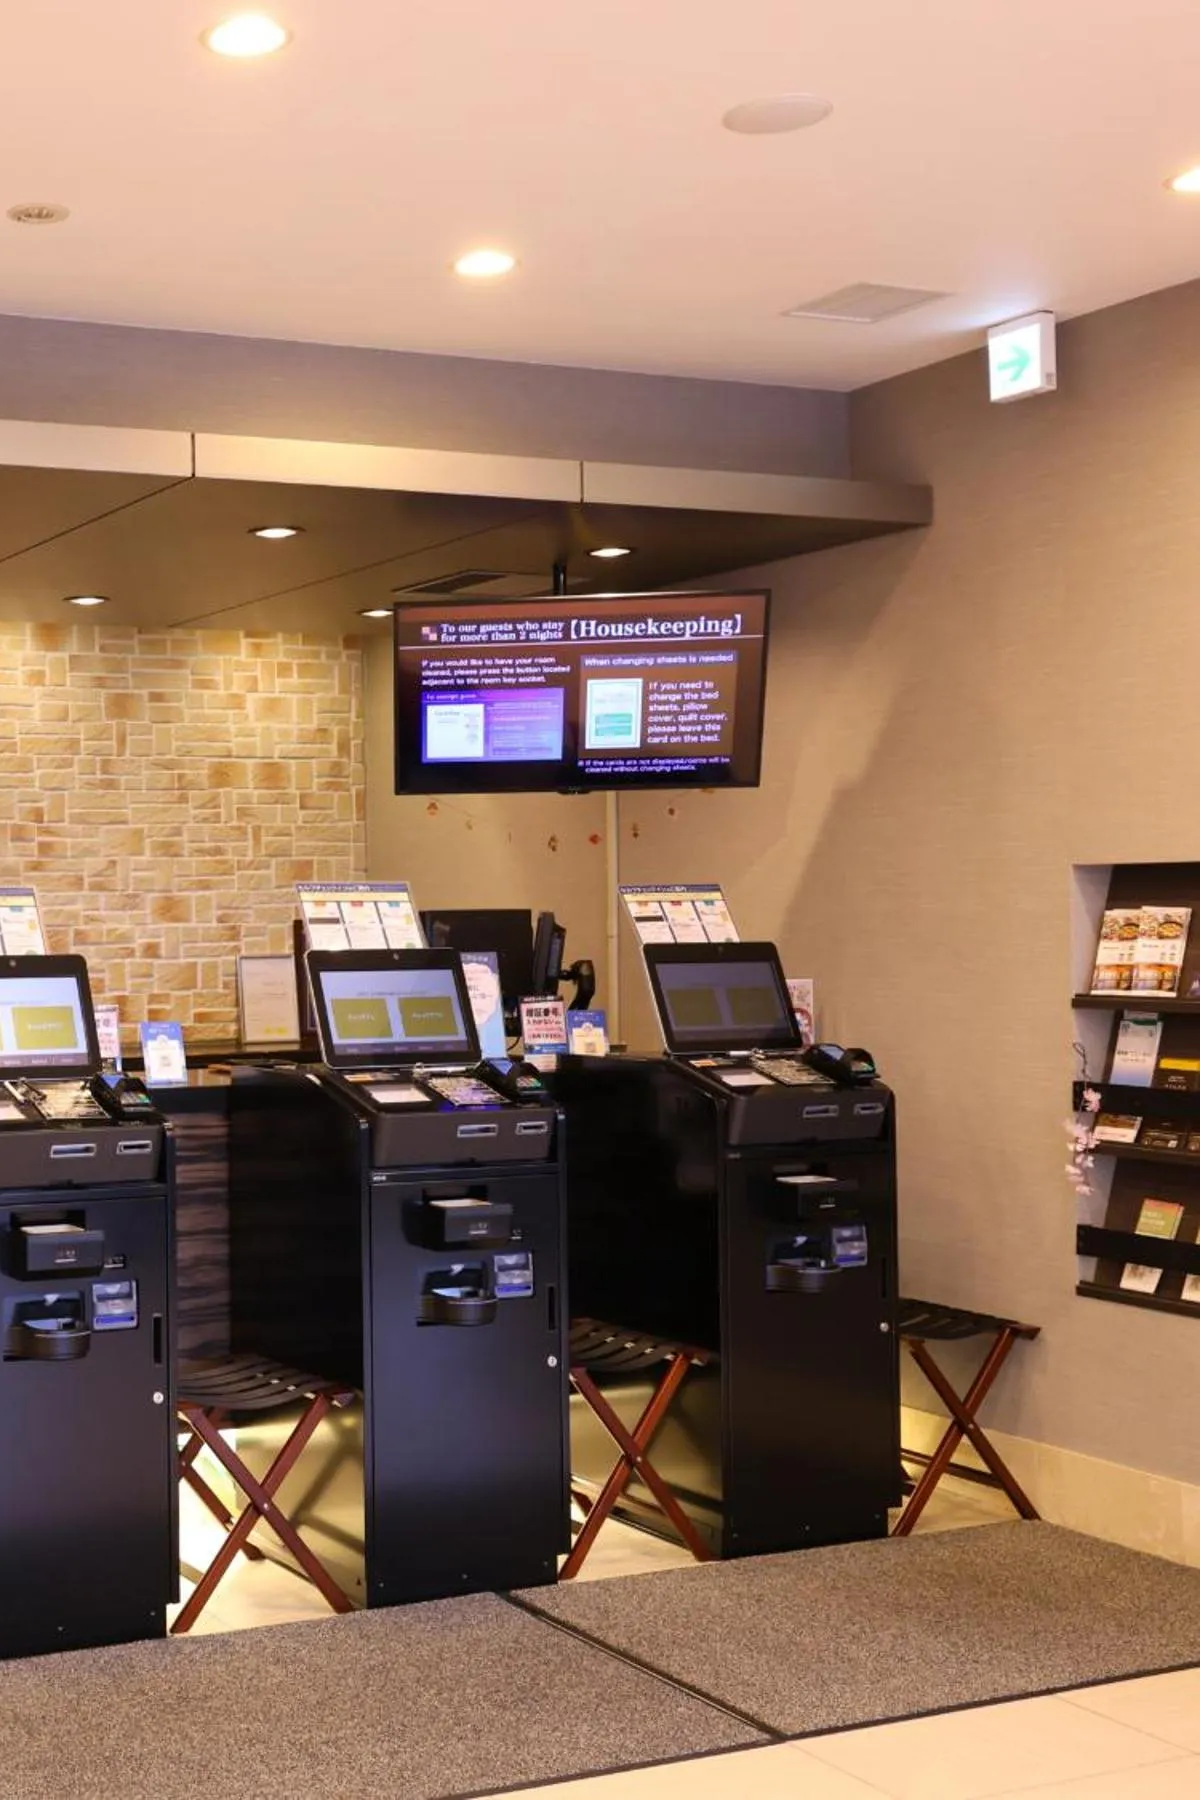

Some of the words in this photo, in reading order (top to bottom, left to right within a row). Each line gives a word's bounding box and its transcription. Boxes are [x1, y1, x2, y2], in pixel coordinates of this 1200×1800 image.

[441, 623, 455, 633] To
[458, 624, 477, 632] our
[480, 623, 513, 634] guests
[516, 621, 539, 631] who
[542, 621, 565, 632] stay
[440, 633, 456, 643] for
[460, 634, 488, 642] more
[491, 632, 516, 641] than
[519, 631, 526, 640] 2
[529, 630, 563, 641] nights
[515, 658, 533, 666] your
[585, 658, 610, 666] When
[612, 656, 654, 667] changing
[657, 655, 687, 664] sheets
[698, 653, 733, 662] needed
[454, 669, 477, 677] please
[543, 665, 570, 673] located
[649, 682, 657, 690] If
[660, 682, 677, 692] you
[680, 681, 701, 689] need
[704, 680, 714, 688] to
[649, 693, 682, 702] change
[684, 692, 699, 700] the
[701, 691, 719, 699] bed
[683, 702, 708, 712] pillow
[648, 725, 677, 734] please
[678, 724, 702, 732] leave
[705, 723, 721, 731] this
[647, 735, 668, 743] card
[684, 735, 698, 743] the
